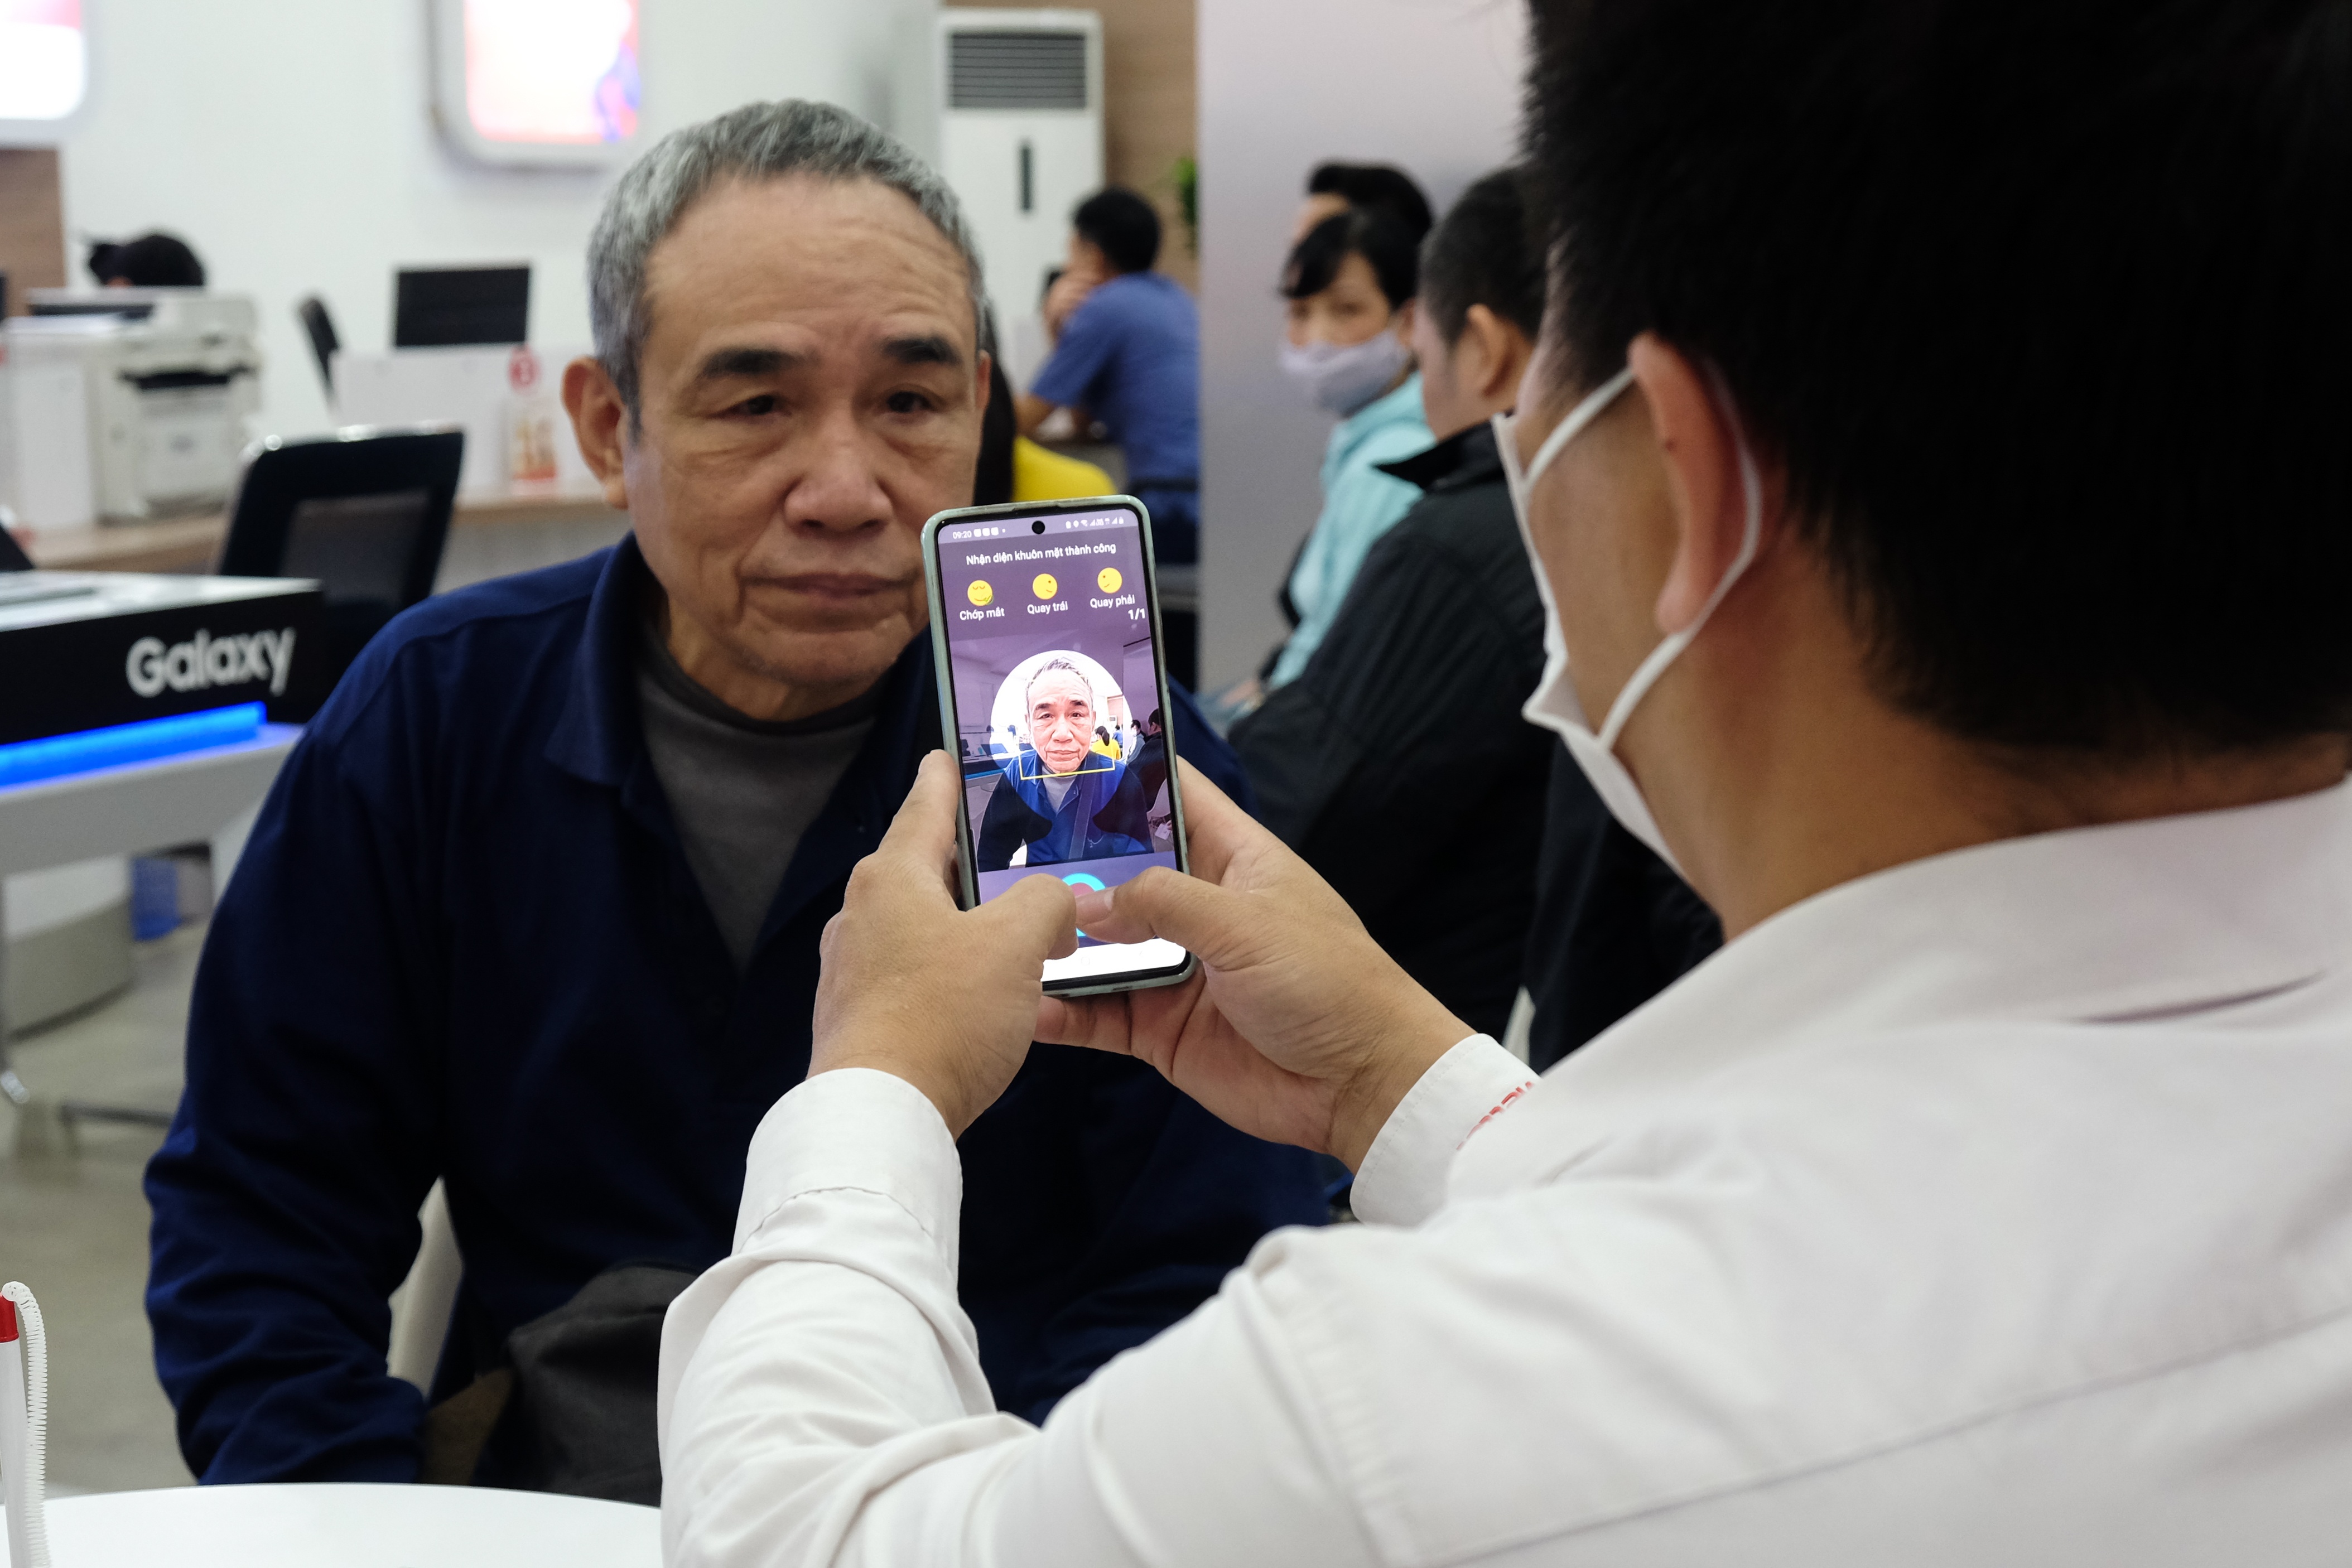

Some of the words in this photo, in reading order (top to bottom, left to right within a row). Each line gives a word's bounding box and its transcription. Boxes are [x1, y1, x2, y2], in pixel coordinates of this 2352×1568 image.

[952, 530, 972, 539] 09:20
[966, 554, 991, 565] Nhận
[992, 552, 1013, 563] diện
[1014, 549, 1043, 561] khuôn
[1045, 547, 1064, 558] mặt
[1064, 544, 1091, 556] thành
[1093, 543, 1116, 554] công
[1027, 604, 1051, 615] Quay
[1052, 601, 1068, 611] trái
[1090, 598, 1114, 609] Quay
[1115, 594, 1135, 607] phải
[1127, 608, 1145, 620] 1/1
[126, 627, 296, 697] Galaxy
